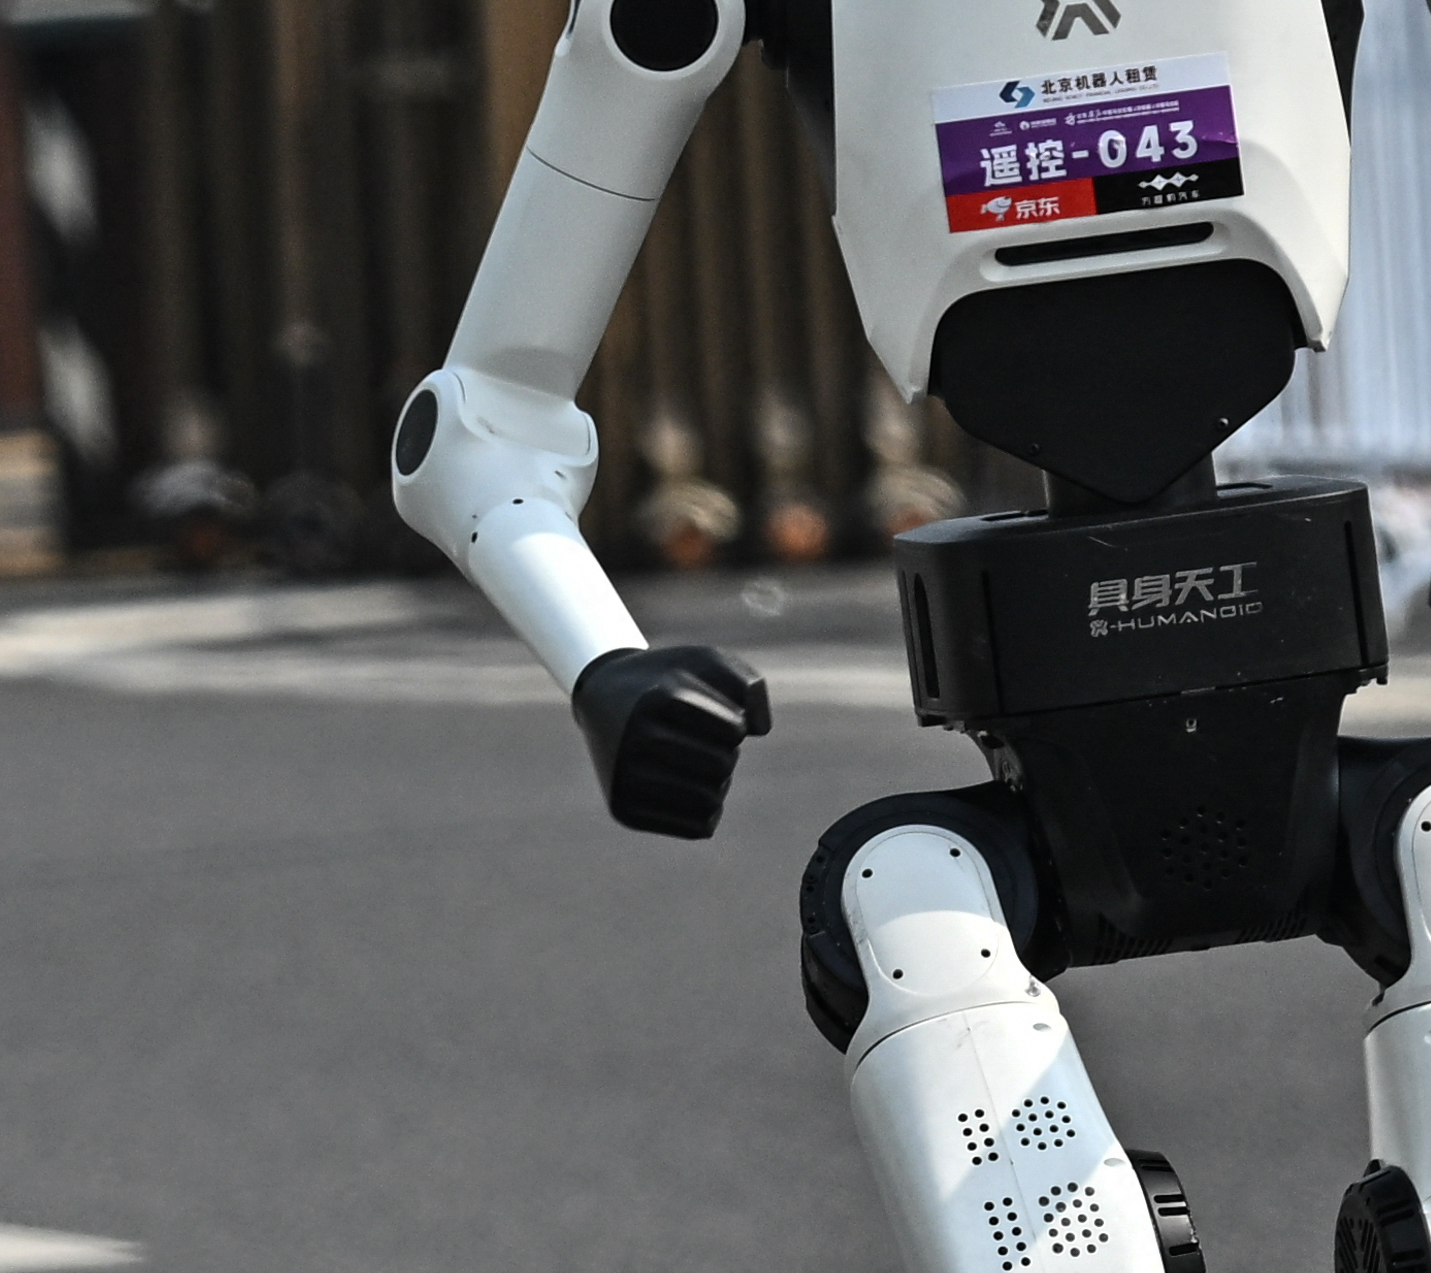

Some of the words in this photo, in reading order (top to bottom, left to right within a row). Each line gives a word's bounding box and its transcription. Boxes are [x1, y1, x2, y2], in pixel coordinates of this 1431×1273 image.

[1041, 65, 1157, 94] 北京机器人租赁
[980, 119, 1198, 187] 遥控-043
[1015, 196, 1060, 219] 京东
[1088, 562, 1258, 616] 具身天工
